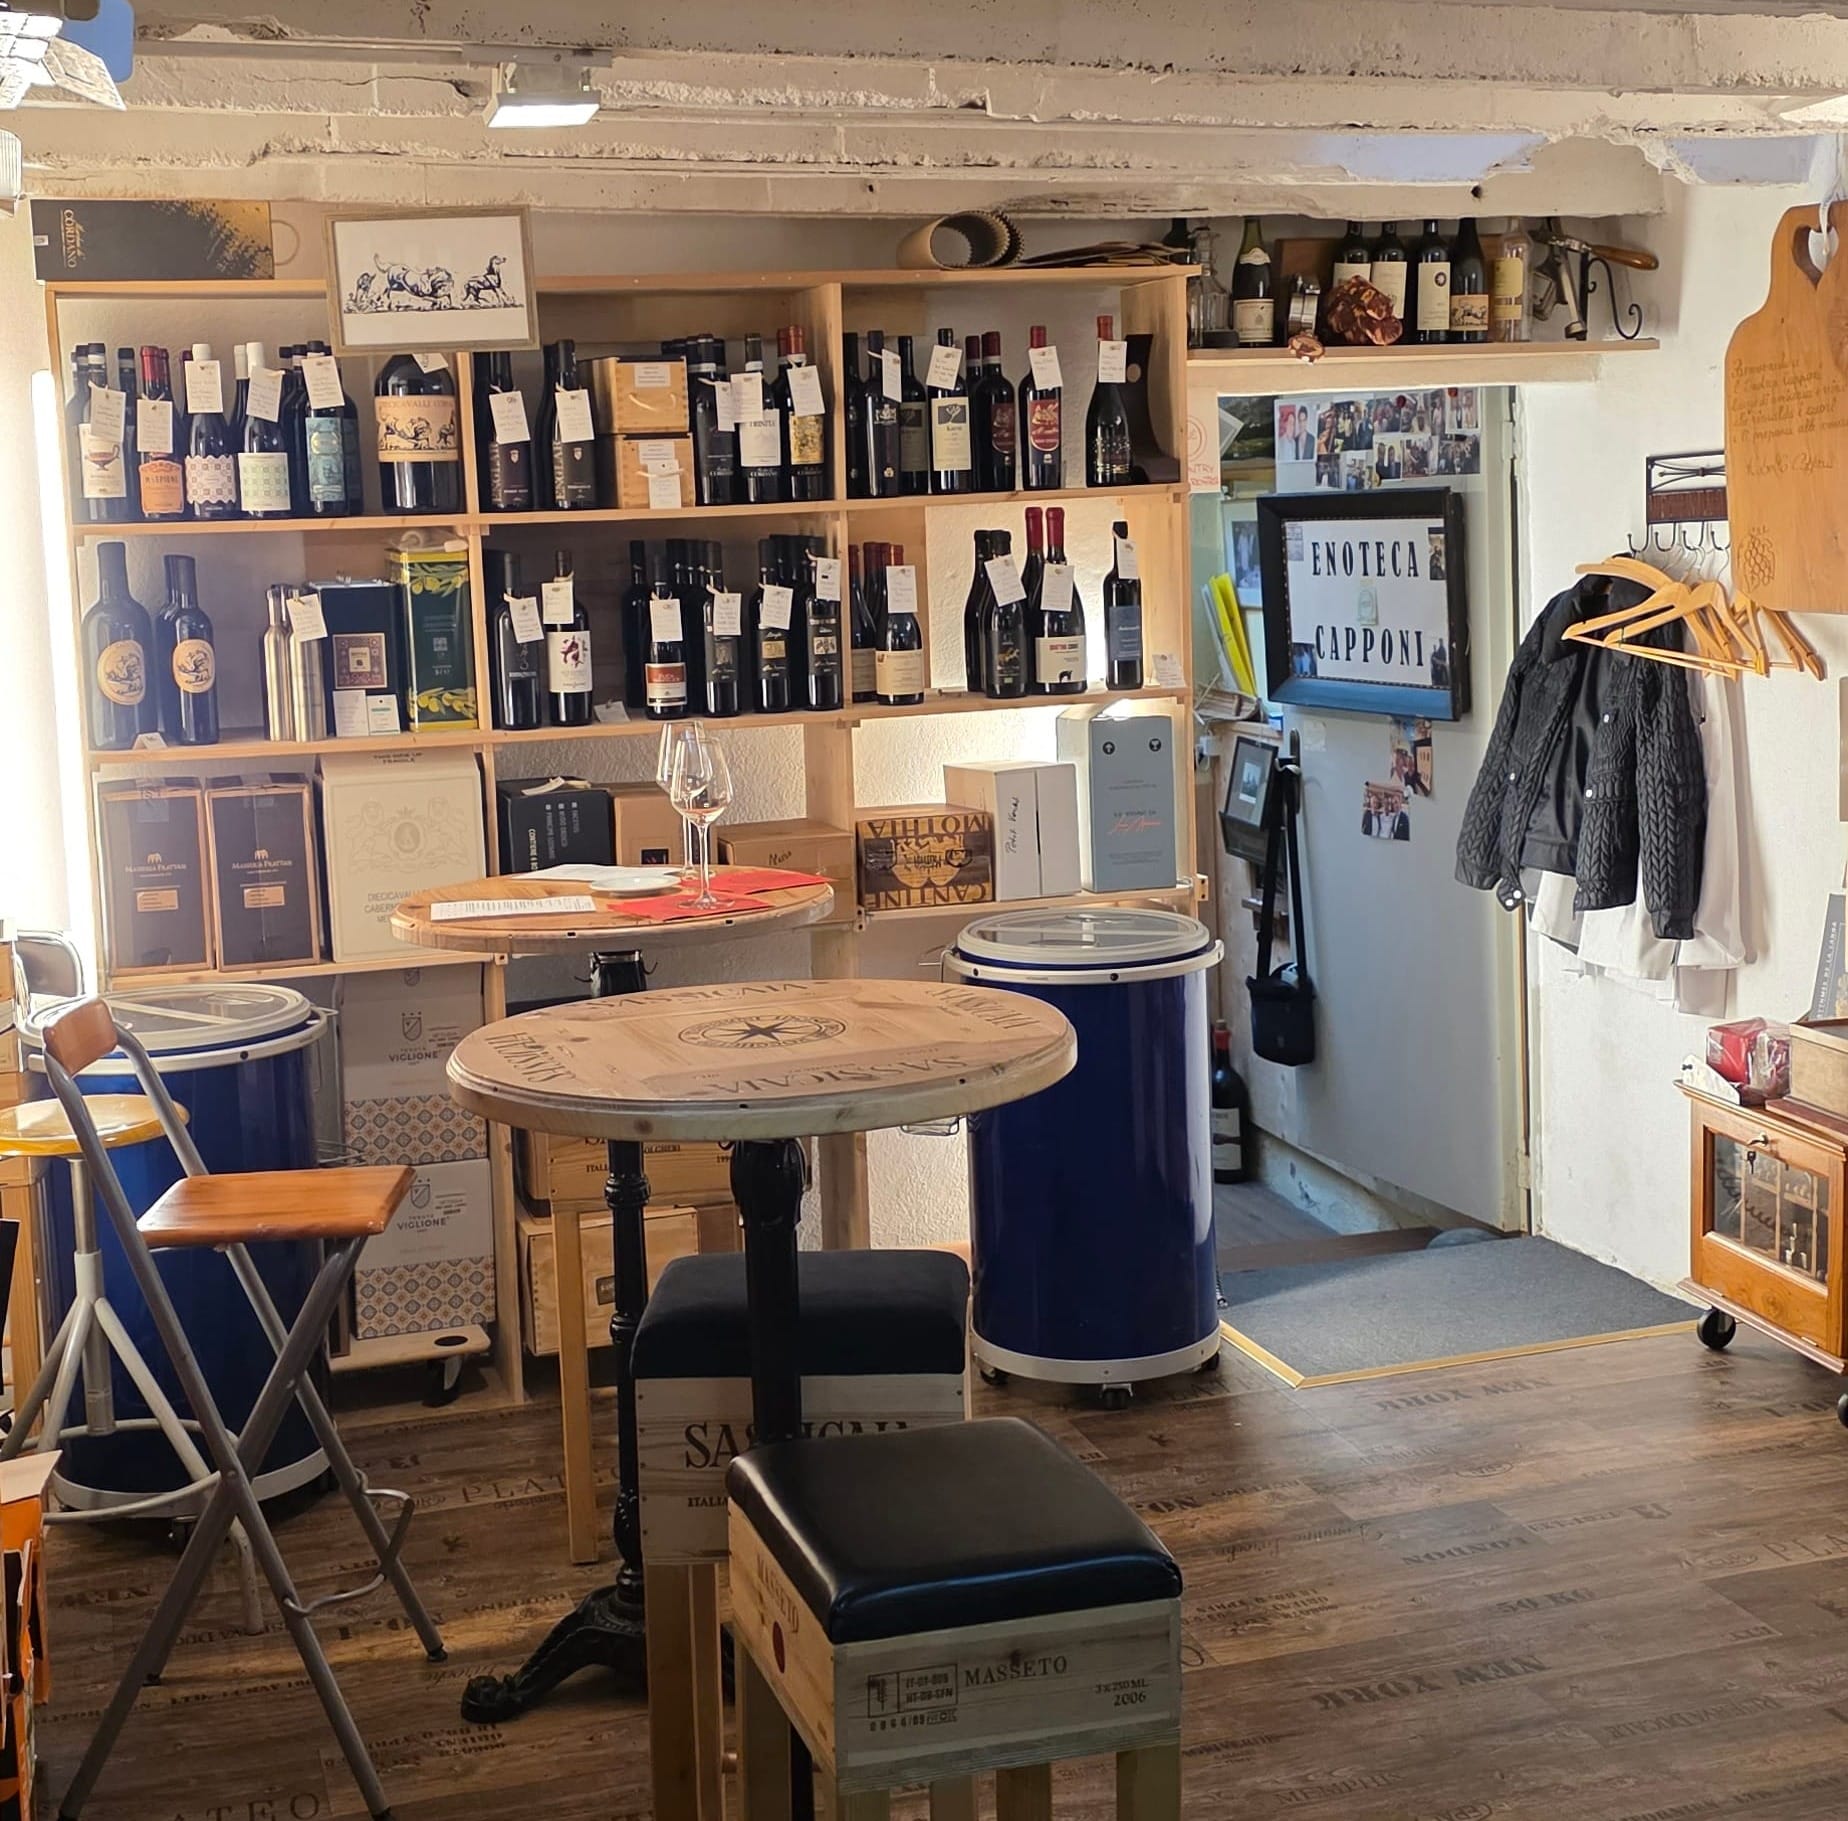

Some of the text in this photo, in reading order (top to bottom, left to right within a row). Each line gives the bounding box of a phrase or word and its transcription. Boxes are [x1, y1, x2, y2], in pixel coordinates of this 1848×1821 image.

[1311, 540, 1419, 578] ENOTECA
[1314, 625, 1425, 667] CAPPONI
[867, 814, 986, 838] MOTHIA
[864, 883, 987, 909] CANTINE
[388, 1050, 439, 1062] VIGLIONE
[706, 1056, 970, 1094] SASSICAIA
[644, 1144, 681, 1154] OLGHERI
[397, 1217, 448, 1231] VIGLIONE
[1402, 1535, 1528, 1566] LONDON
[964, 1655, 1068, 1687] MASSETO
[1311, 1654, 1551, 1713] NEW YORK
[1112, 1690, 1147, 1707] 2006
